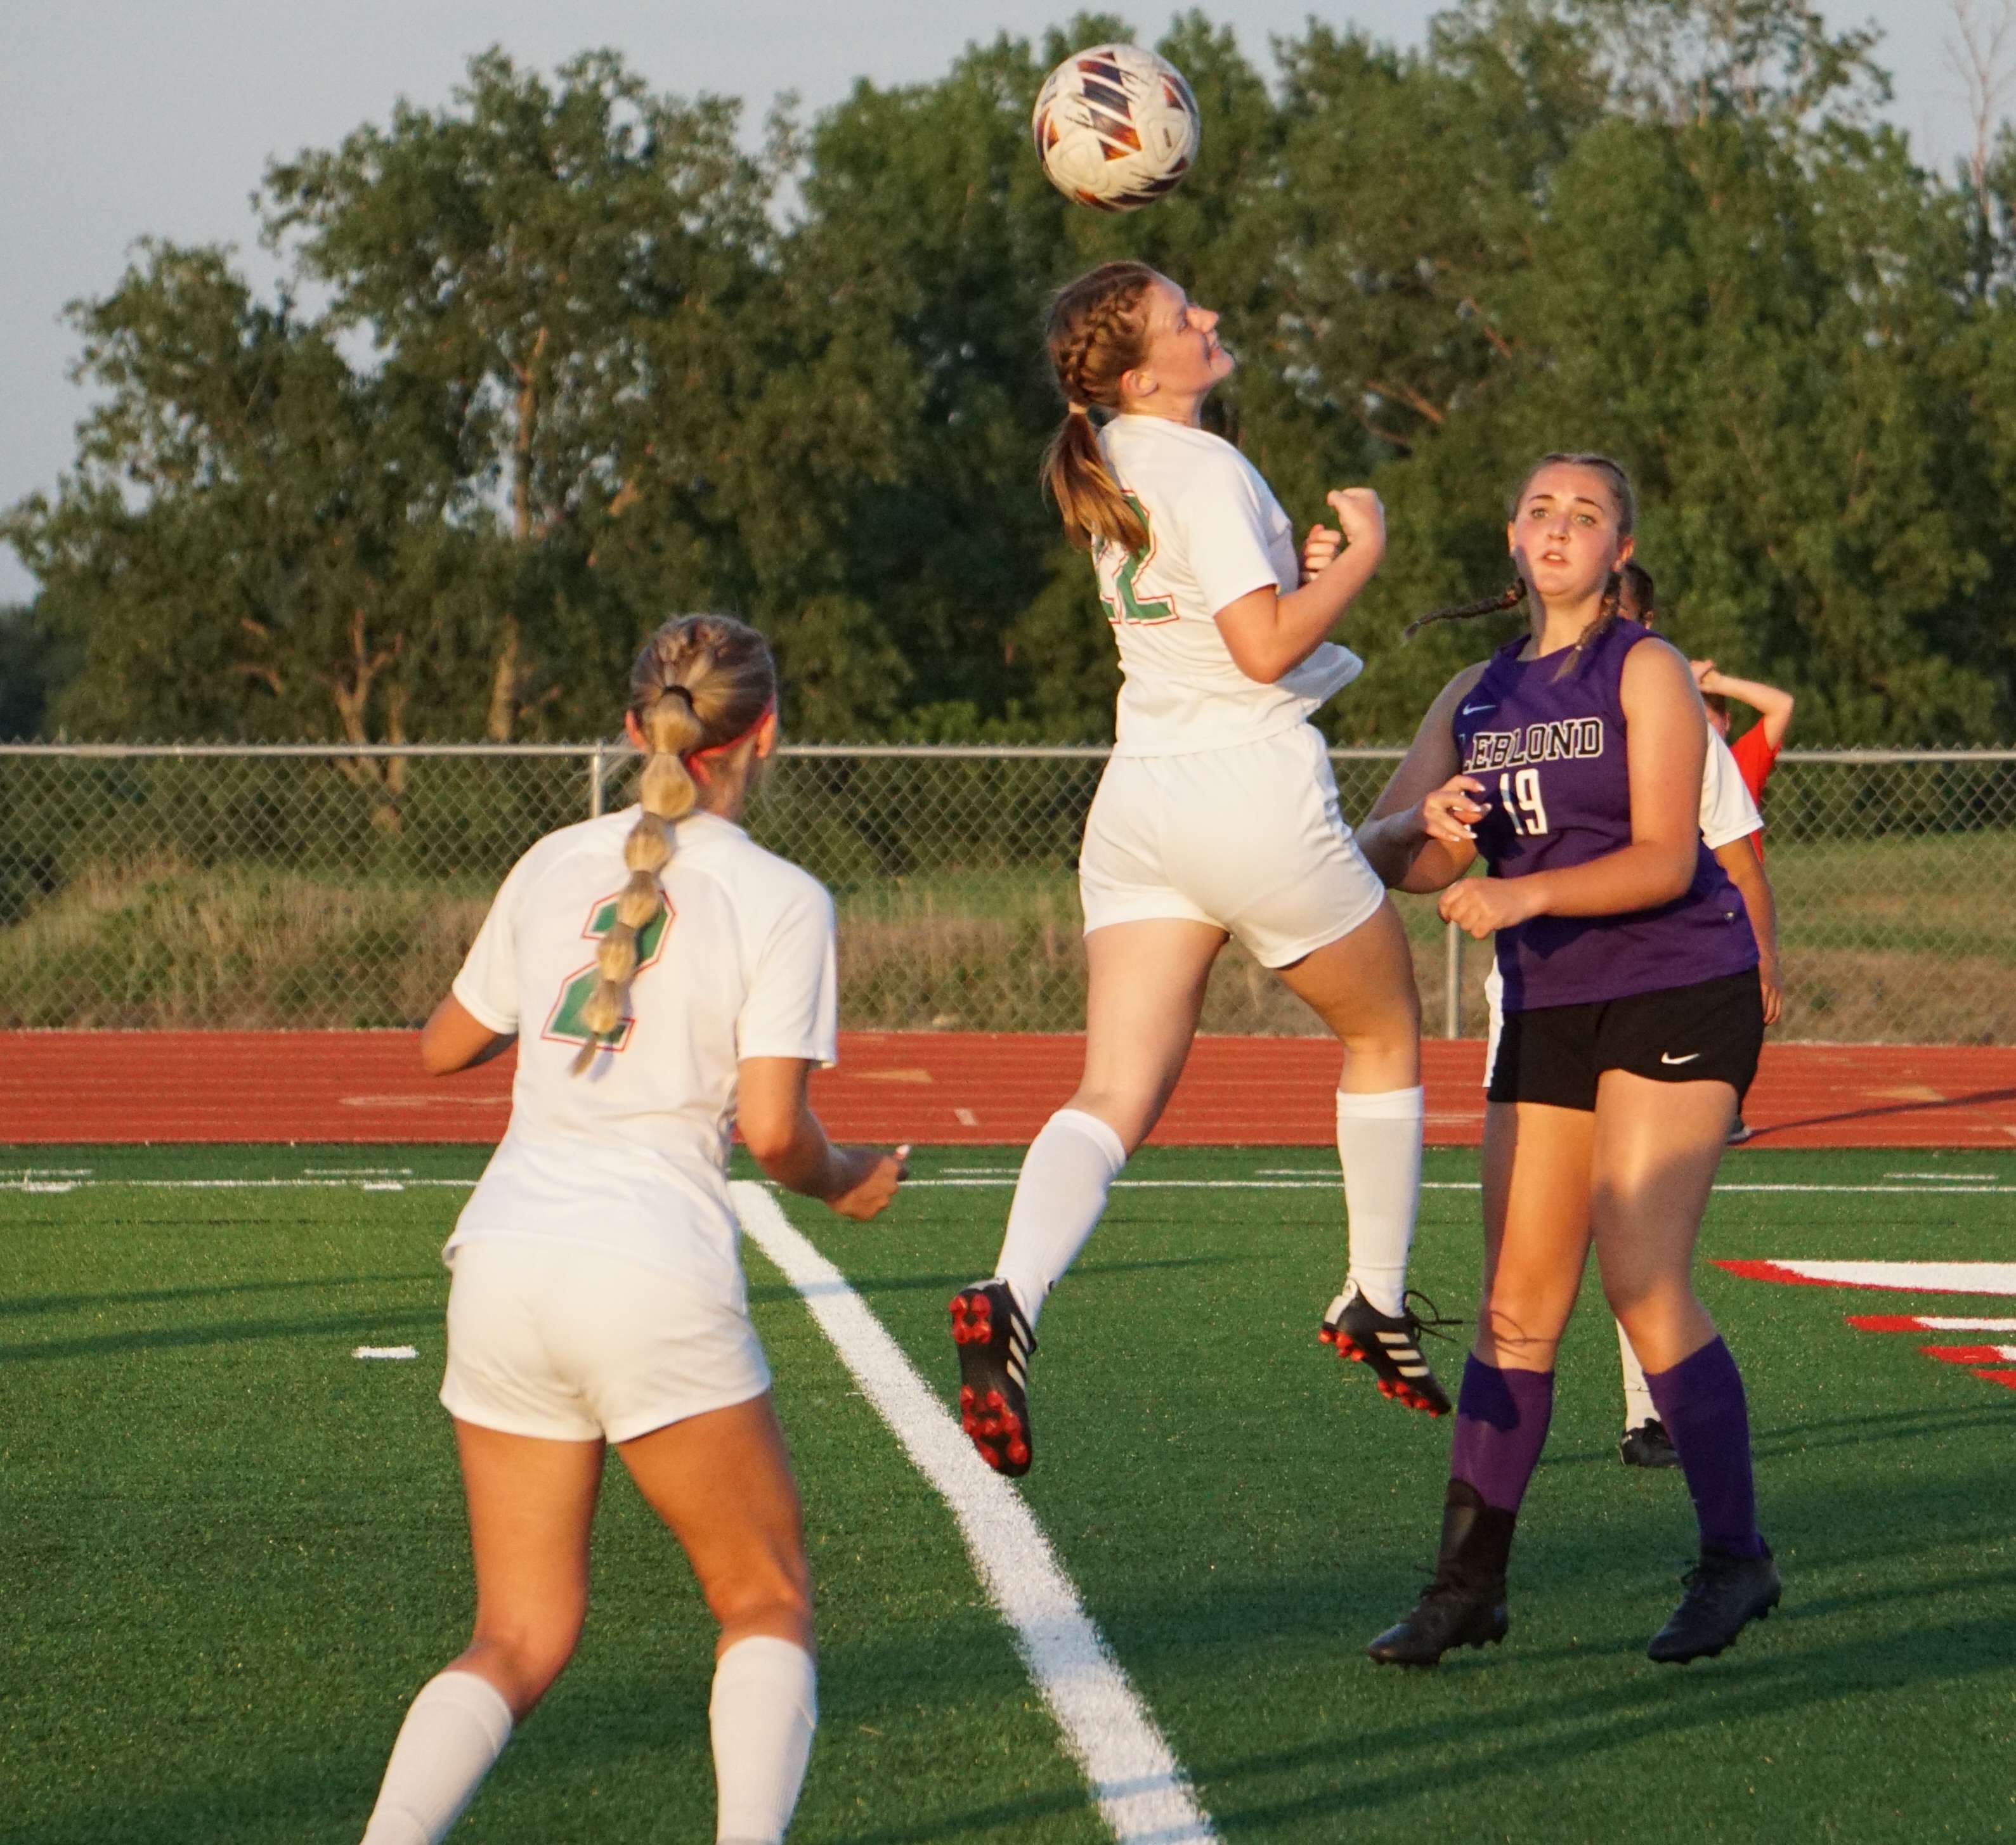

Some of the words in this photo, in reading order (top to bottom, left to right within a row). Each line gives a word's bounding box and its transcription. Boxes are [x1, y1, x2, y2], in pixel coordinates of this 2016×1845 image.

[1091, 489, 1180, 626] 2
[1499, 768, 1548, 835] 19
[540, 889, 676, 1052] 2
